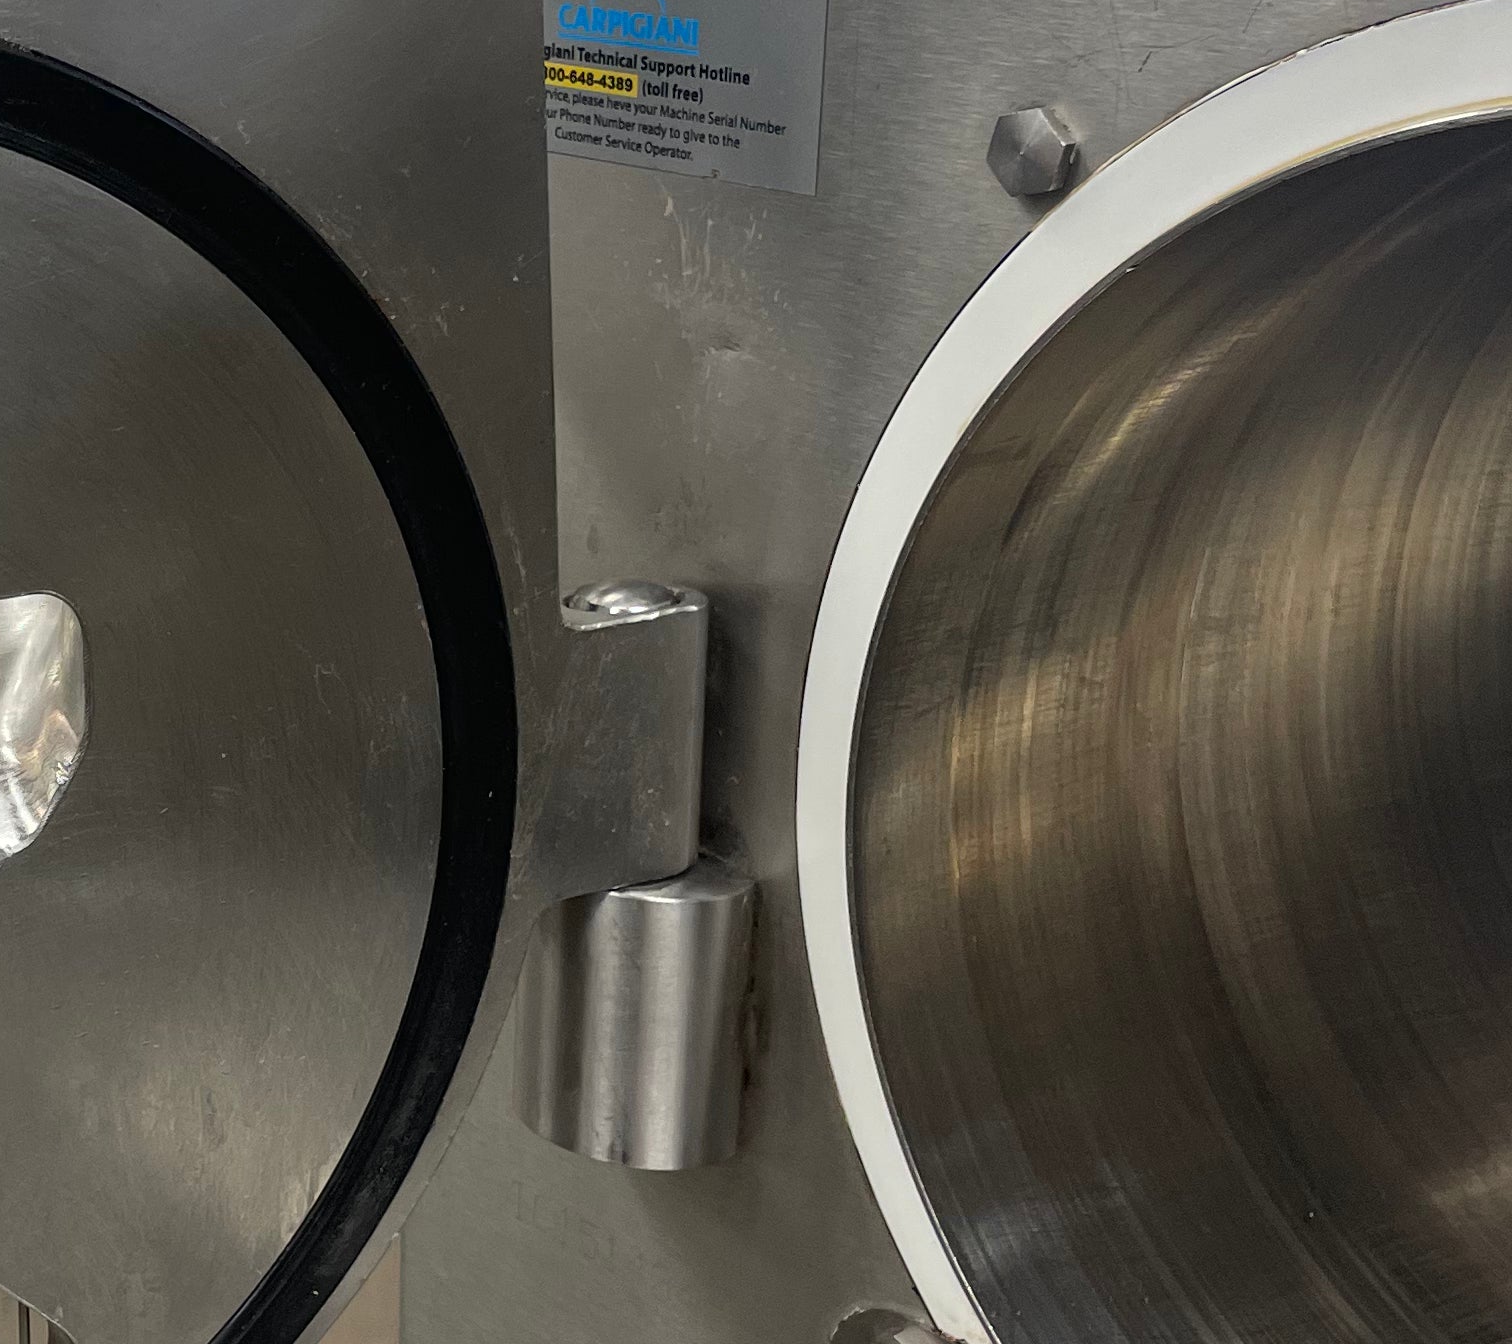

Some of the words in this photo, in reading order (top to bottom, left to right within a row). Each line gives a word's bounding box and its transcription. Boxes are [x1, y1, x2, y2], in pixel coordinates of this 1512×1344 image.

[557, 2, 700, 48] CARPIGIANI
[577, 47, 638, 70] Technical
[640, 56, 696, 78] Support
[699, 63, 751, 86] Hotline
[642, 79, 669, 99] (toll
[672, 84, 704, 106] free)
[560, 107, 591, 125] Phone
[593, 114, 635, 132] Number
[638, 122, 668, 140] ready
[669, 126, 680, 139] to
[683, 129, 706, 144] give
[708, 132, 720, 146] to
[722, 133, 741, 150] the
[572, 92, 604, 110] please
[633, 103, 658, 117] your
[660, 104, 706, 124] Machine
[708, 111, 738, 130] Serial
[740, 116, 787, 136] Number
[554, 126, 604, 146] Customer
[605, 134, 643, 153] Service
